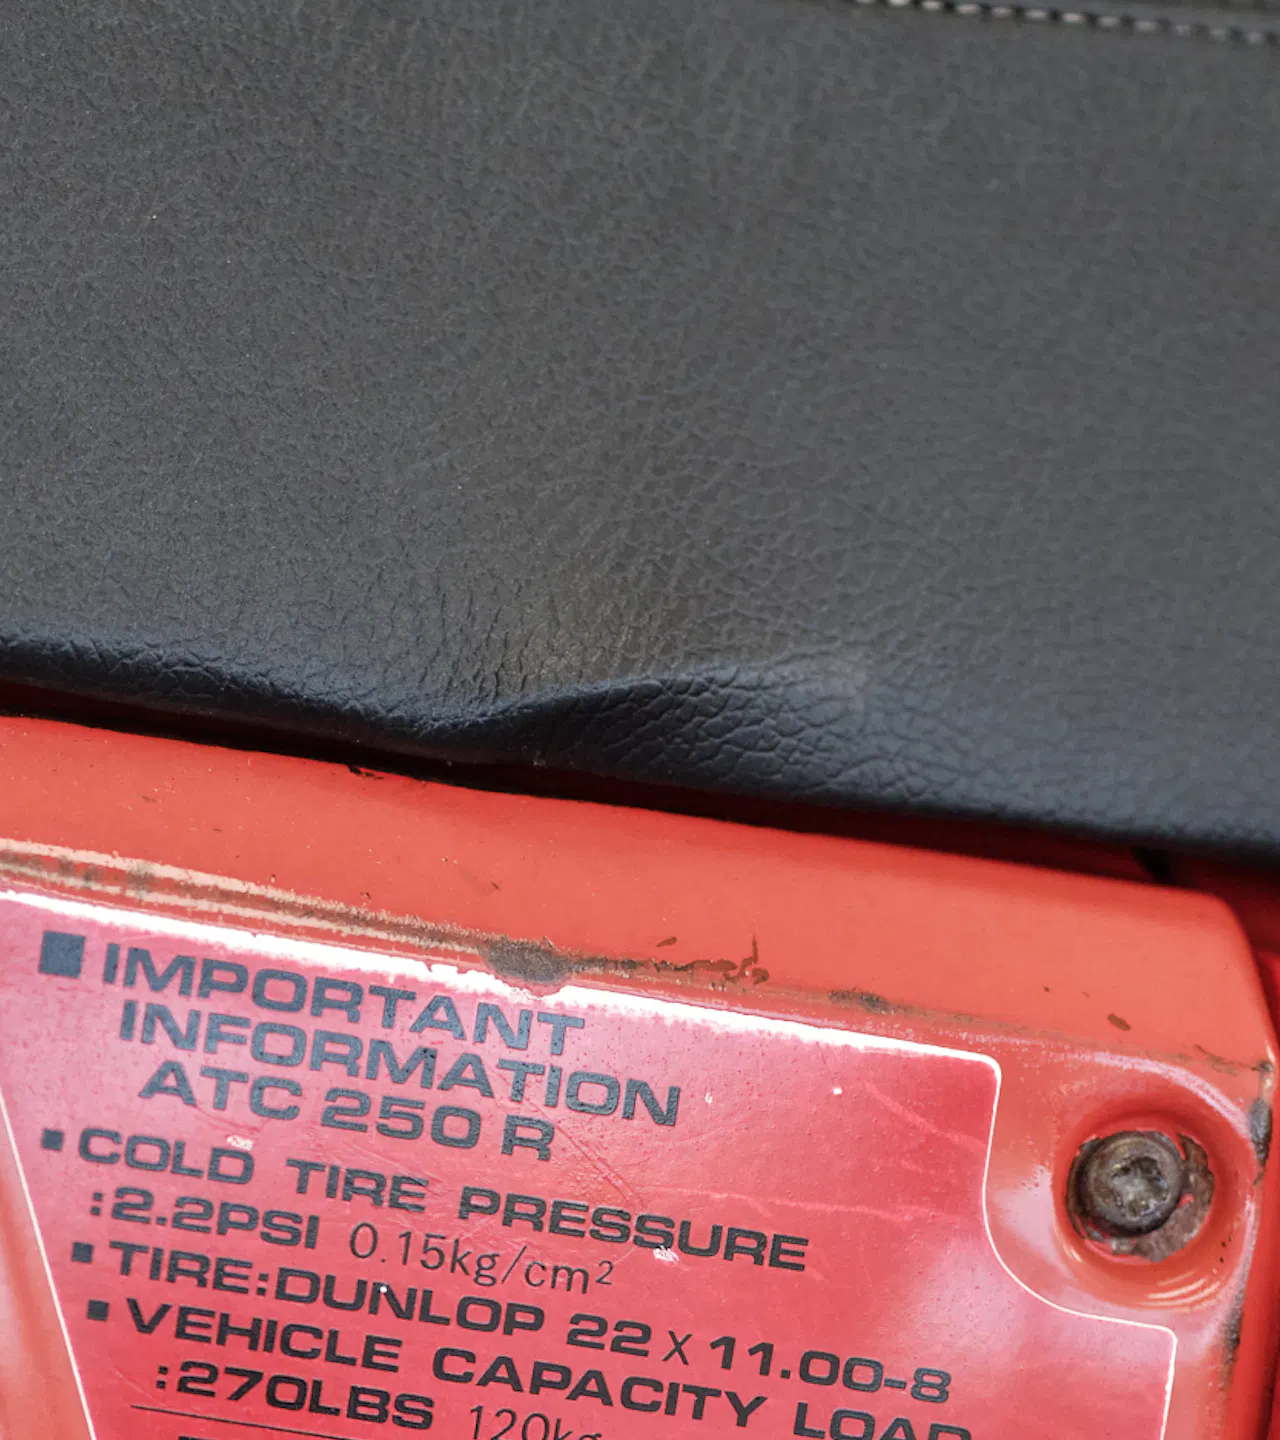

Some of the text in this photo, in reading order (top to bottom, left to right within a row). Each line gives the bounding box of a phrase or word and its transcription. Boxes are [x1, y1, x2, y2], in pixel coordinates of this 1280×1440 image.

[104, 943, 585, 1055] IMPORTANT
[120, 1000, 681, 1126] INFORMATION
[139, 1061, 554, 1161] ATC 250 R
[79, 1128, 809, 1272] COLD TIRE PRESSURE
[127, 1298, 402, 1372] VEHICLE
[433, 1348, 767, 1427] CAPACITY
